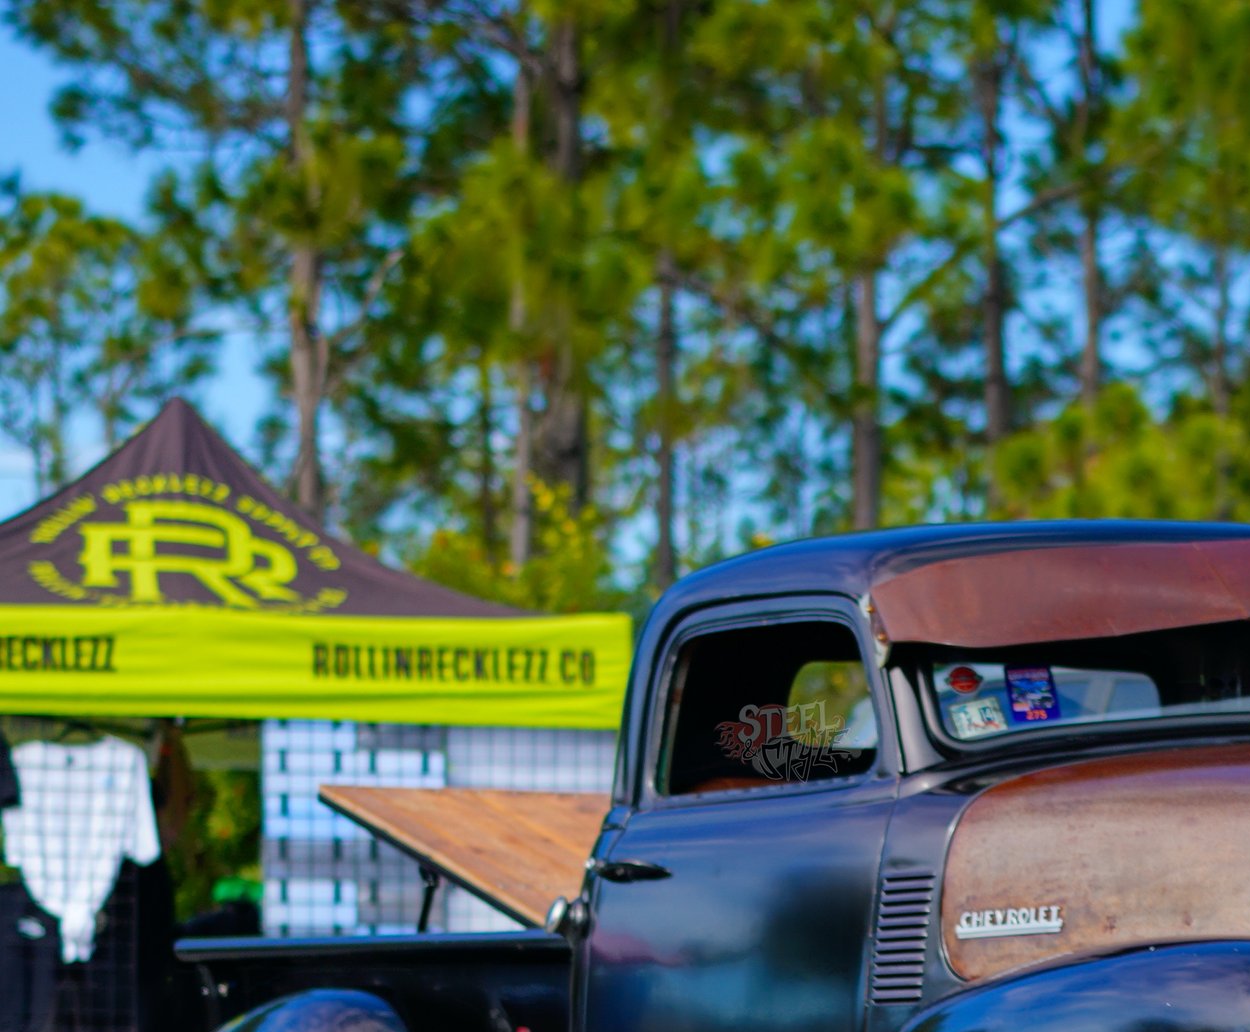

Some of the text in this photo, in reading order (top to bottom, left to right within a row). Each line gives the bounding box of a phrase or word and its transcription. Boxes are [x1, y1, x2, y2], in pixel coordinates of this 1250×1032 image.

[312, 643, 596, 686] ROLLINRECKLEZZ CO
[1026, 709, 1048, 721] 275
[959, 905, 1061, 929] CHEVROLET
